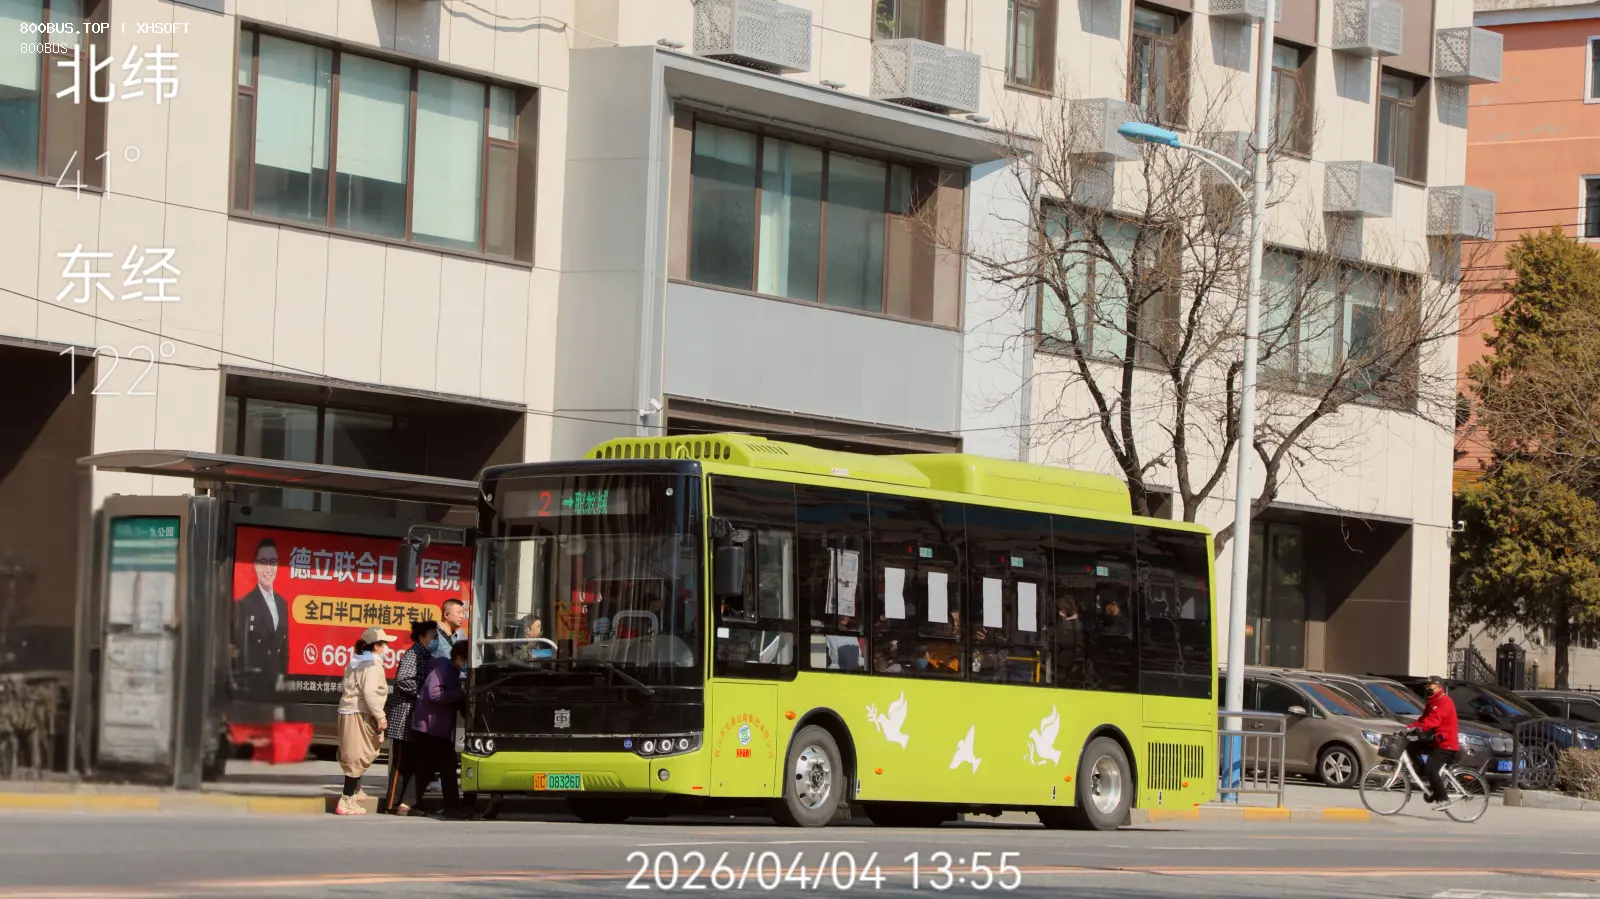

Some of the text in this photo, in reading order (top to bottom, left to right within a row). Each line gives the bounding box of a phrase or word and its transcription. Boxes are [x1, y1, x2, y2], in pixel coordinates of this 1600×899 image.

[539, 491, 551, 516] 2
[289, 546, 461, 591] 德立联合口医院
[304, 600, 433, 626] 全口半口种植牙专业
